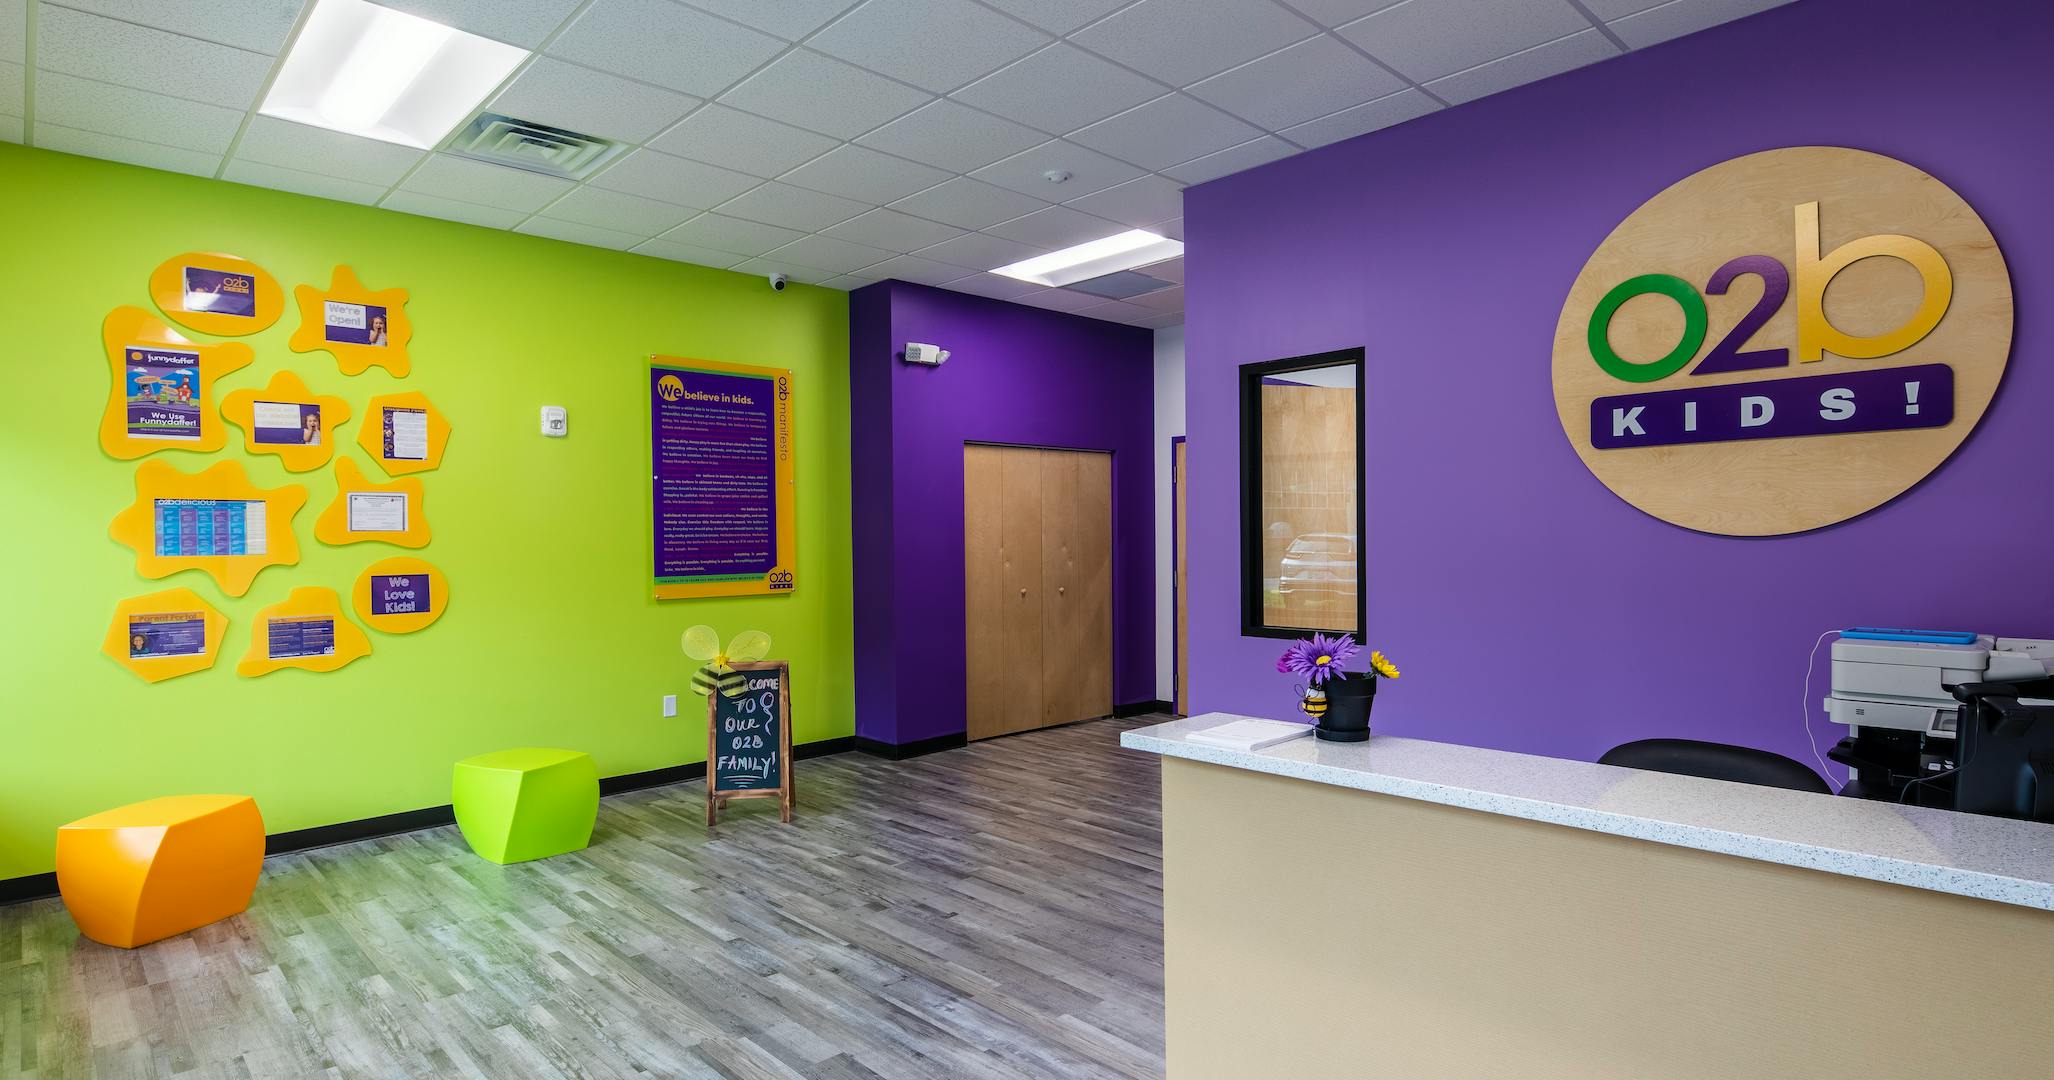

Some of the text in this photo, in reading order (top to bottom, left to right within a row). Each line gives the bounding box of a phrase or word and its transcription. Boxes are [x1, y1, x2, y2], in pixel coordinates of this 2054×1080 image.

[223, 276, 249, 289] o2b
[1588, 201, 1953, 383] o2b
[328, 303, 360, 316] We're
[329, 314, 360, 326] Open!
[658, 383, 754, 405] We believe in kids.
[151, 411, 185, 421] We Use
[1612, 381, 1920, 438] KIDS!
[140, 417, 197, 427] Funnydaffer!
[779, 376, 789, 460] o2b manifesto
[770, 569, 792, 582] o2b
[388, 577, 410, 588] We
[384, 590, 415, 601] Love
[385, 601, 415, 613] Kids!
[731, 698, 756, 713] TO
[717, 751, 776, 779] FAMILY!
